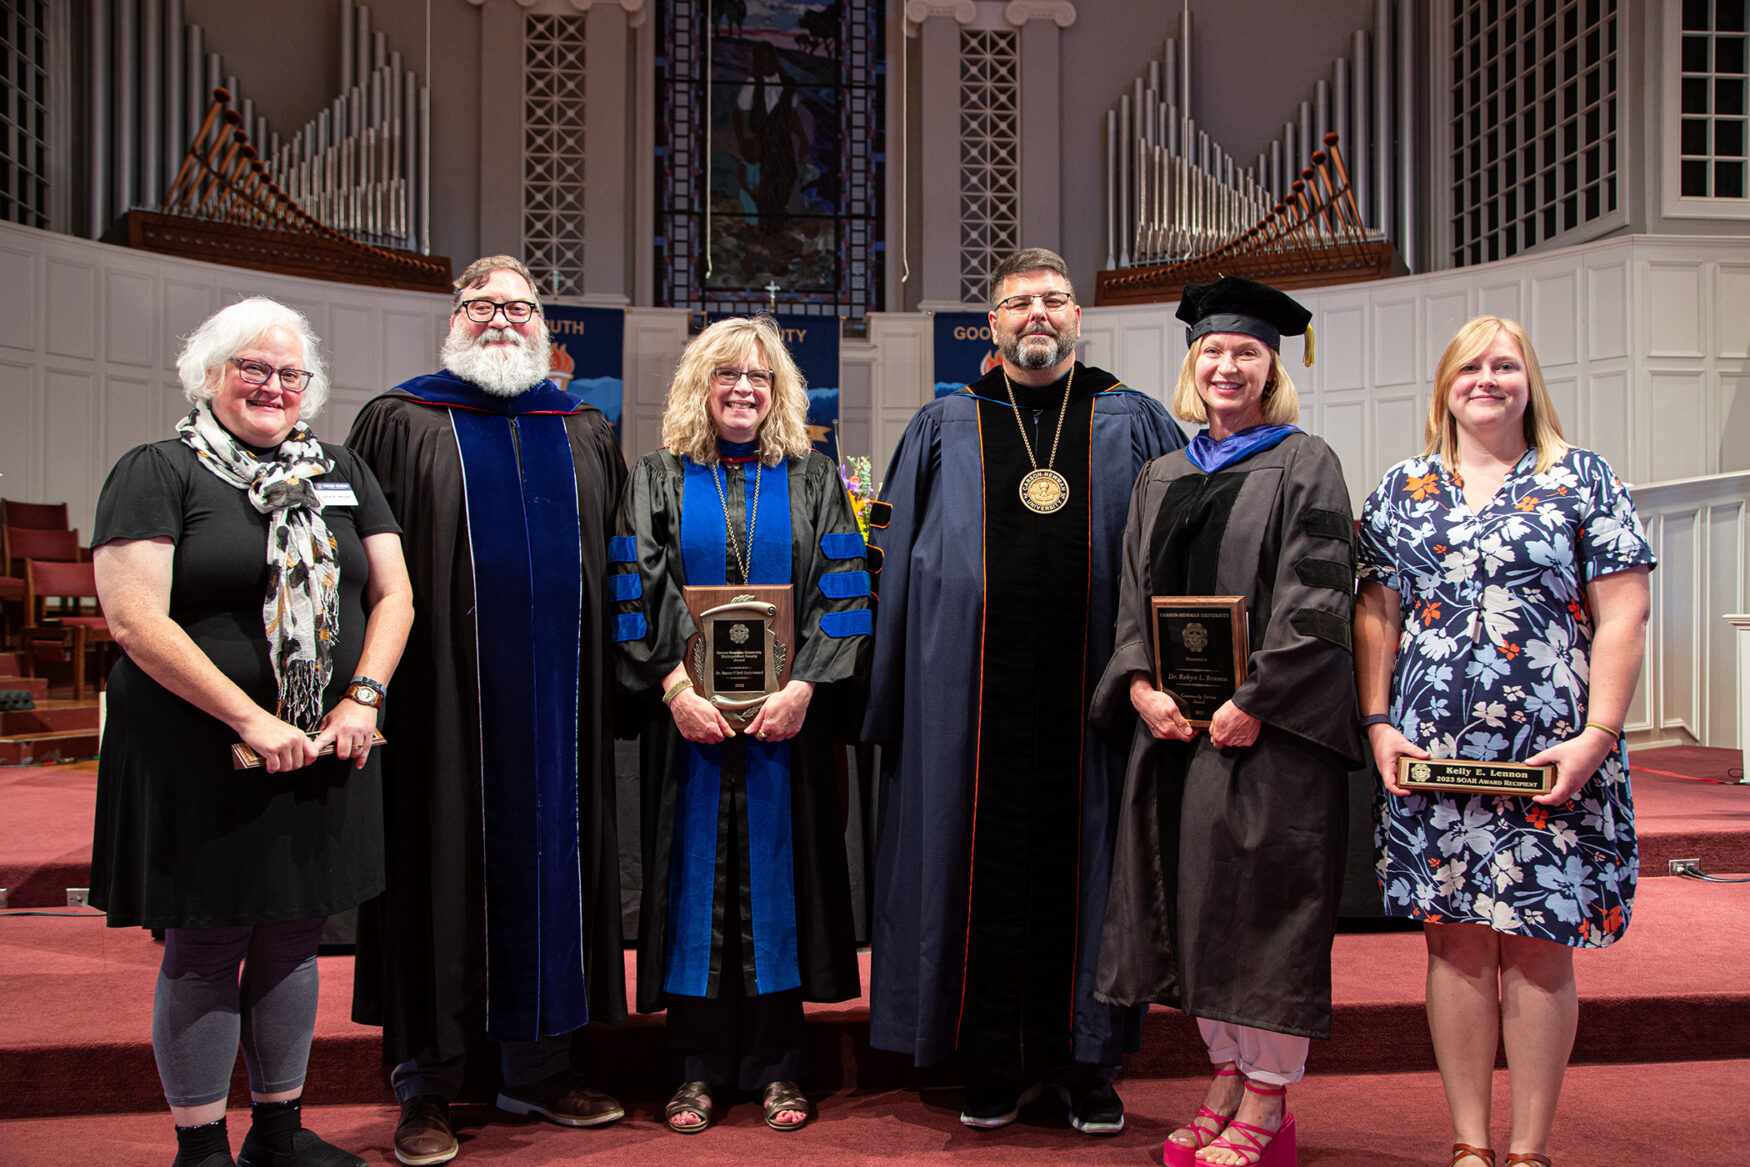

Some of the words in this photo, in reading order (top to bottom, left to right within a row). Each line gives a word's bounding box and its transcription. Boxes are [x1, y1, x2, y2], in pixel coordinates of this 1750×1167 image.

[1022, 471, 1066, 491] CARSON-NEWMAN
[1026, 499, 1062, 511] UNIVERSITY
[1445, 767, 1471, 777] Kelly
[1475, 768, 1486, 776] E.
[1490, 769, 1529, 779] Lennon
[1436, 775, 1455, 783] 2023
[1456, 776, 1478, 784] SOAR
